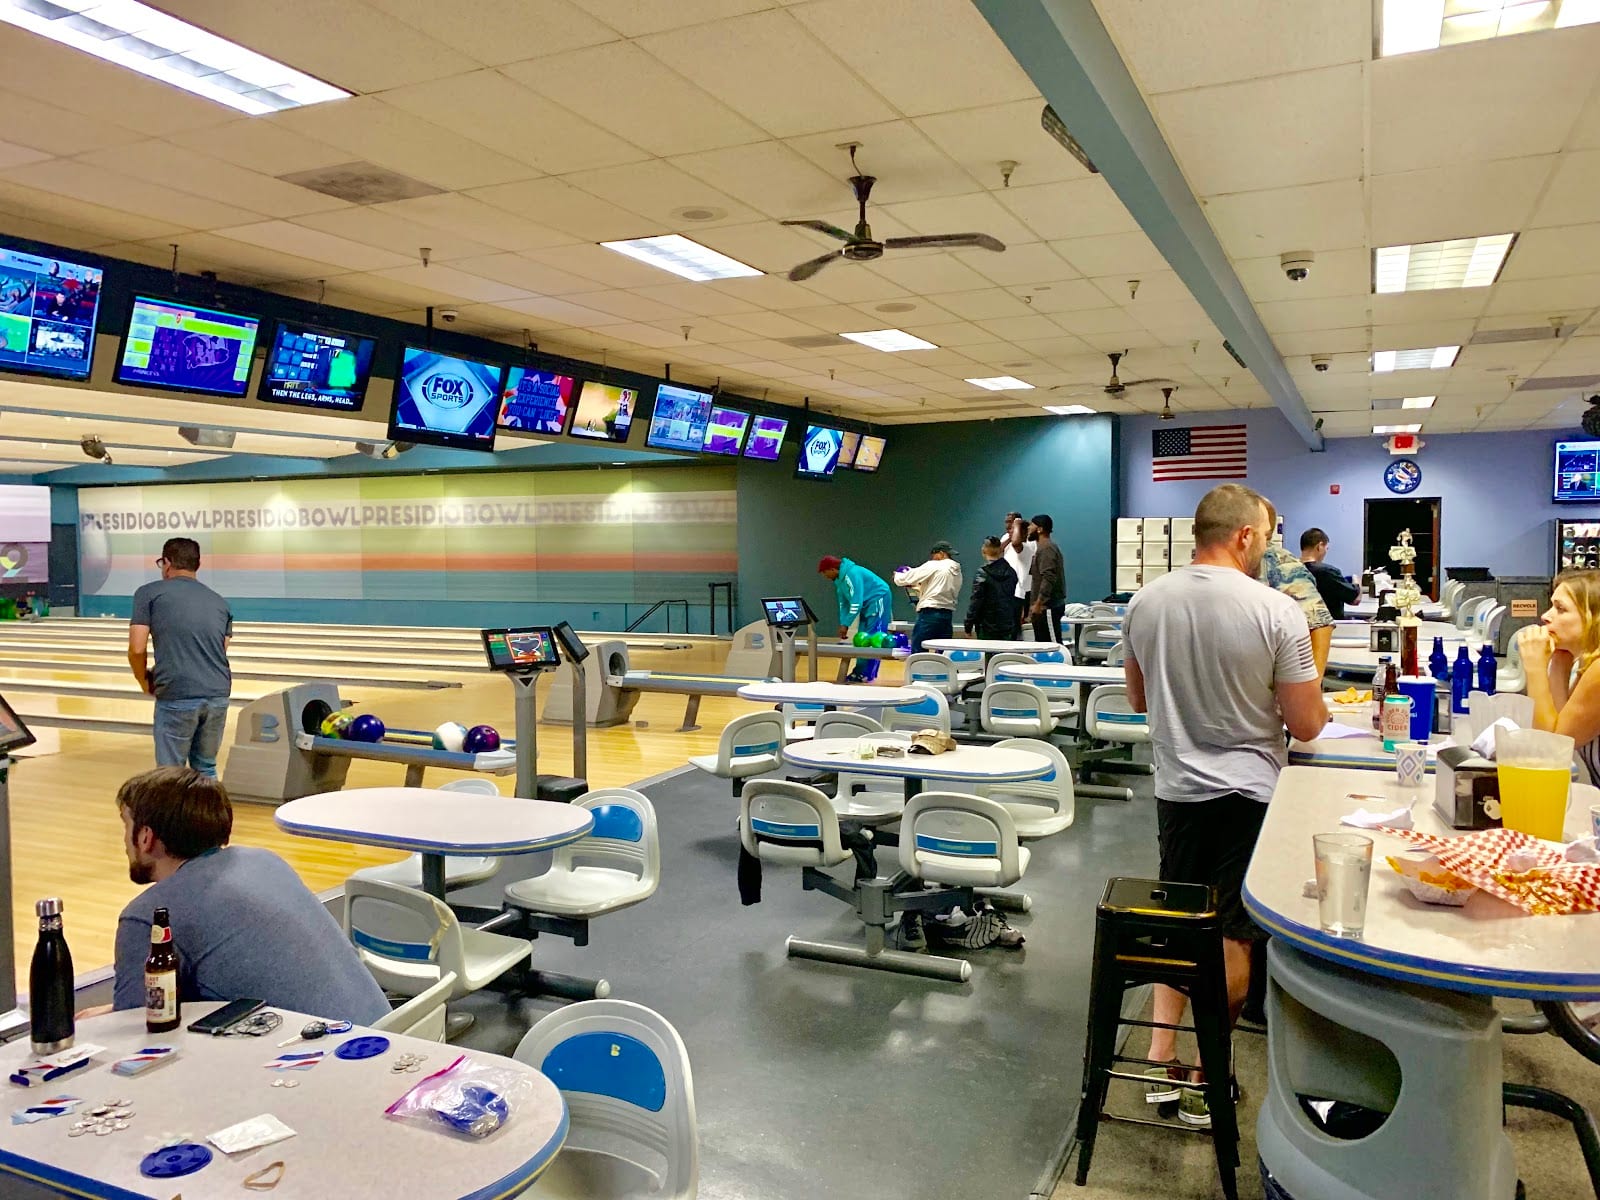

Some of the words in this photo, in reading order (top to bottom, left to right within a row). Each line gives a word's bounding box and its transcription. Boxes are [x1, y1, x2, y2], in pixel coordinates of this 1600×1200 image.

[433, 376, 464, 396] FOX
[272, 388, 288, 397] THEN
[289, 390, 301, 399] THE
[301, 392, 317, 401] LEGS,
[318, 394, 334, 403] ARMS,
[431, 392, 464, 403] SPORTS
[815, 441, 828, 450] FOX
